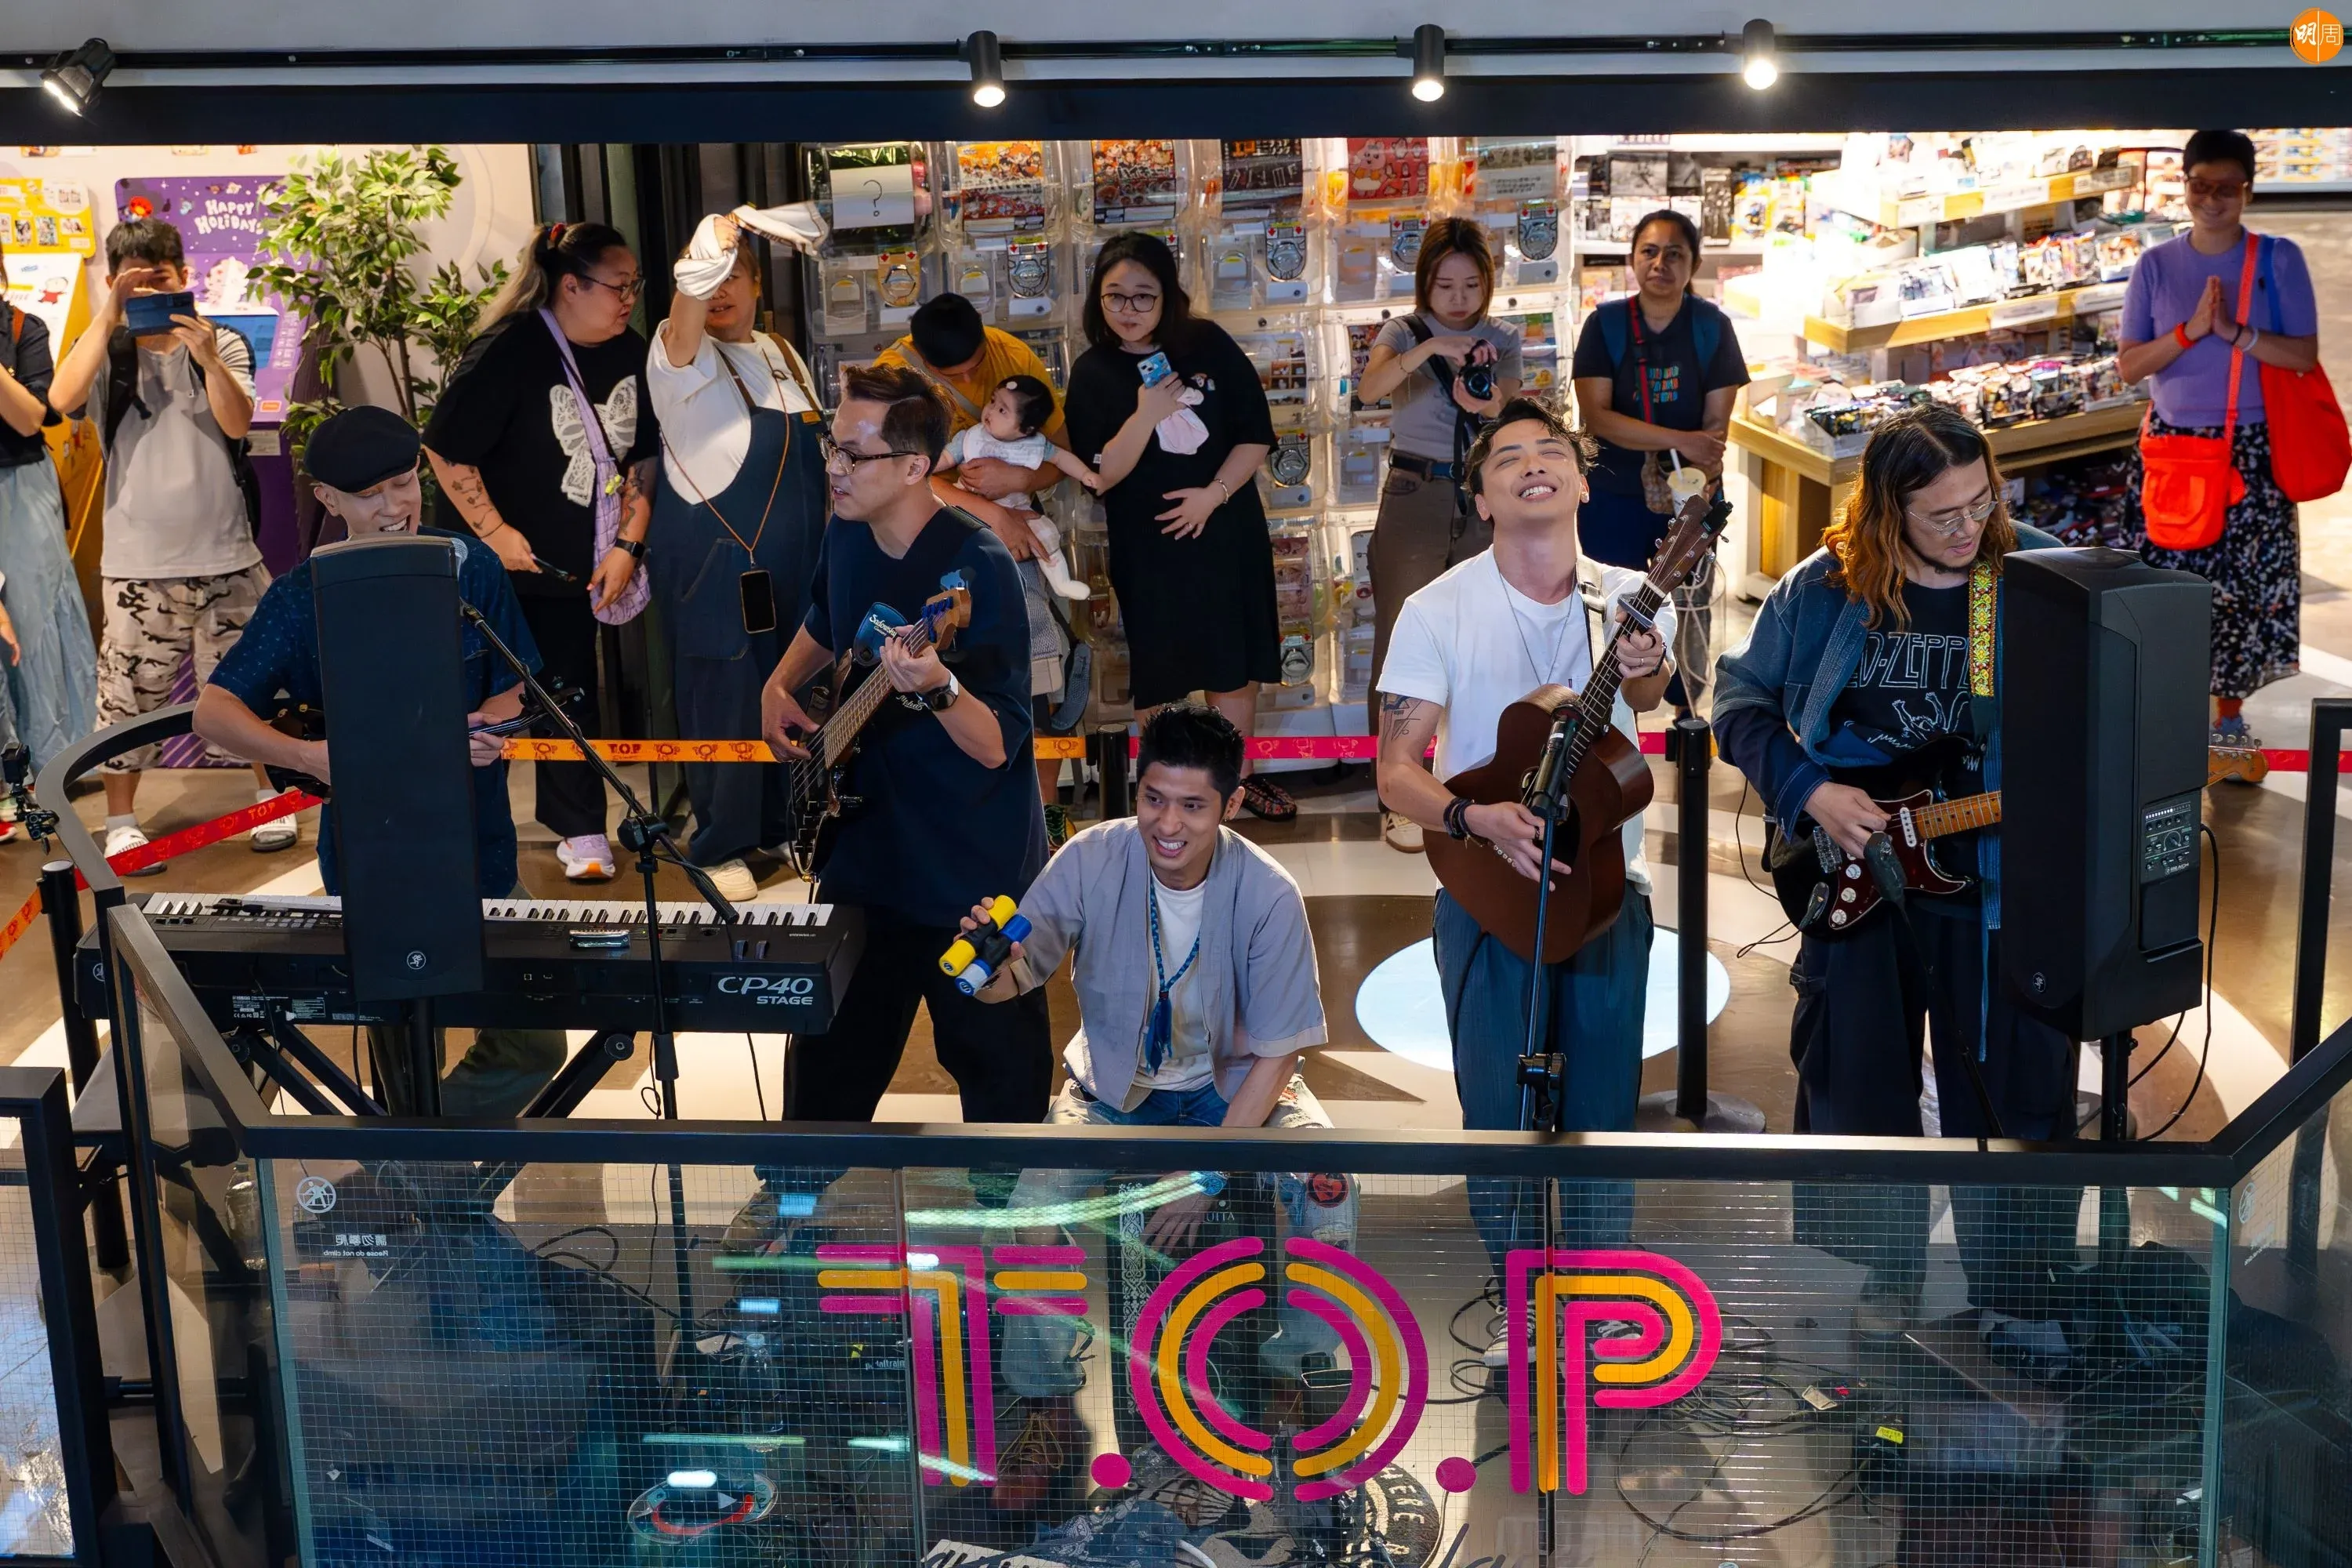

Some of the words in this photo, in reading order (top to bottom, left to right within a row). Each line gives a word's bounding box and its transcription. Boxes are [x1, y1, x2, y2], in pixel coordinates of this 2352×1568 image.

[205, 199, 254, 216] HAPPY
[869, 614, 898, 639] Sadowsky
[717, 976, 814, 995] CP40
[757, 996, 814, 1005] STAGE
[815, 1236, 1722, 1501] T.O.P
